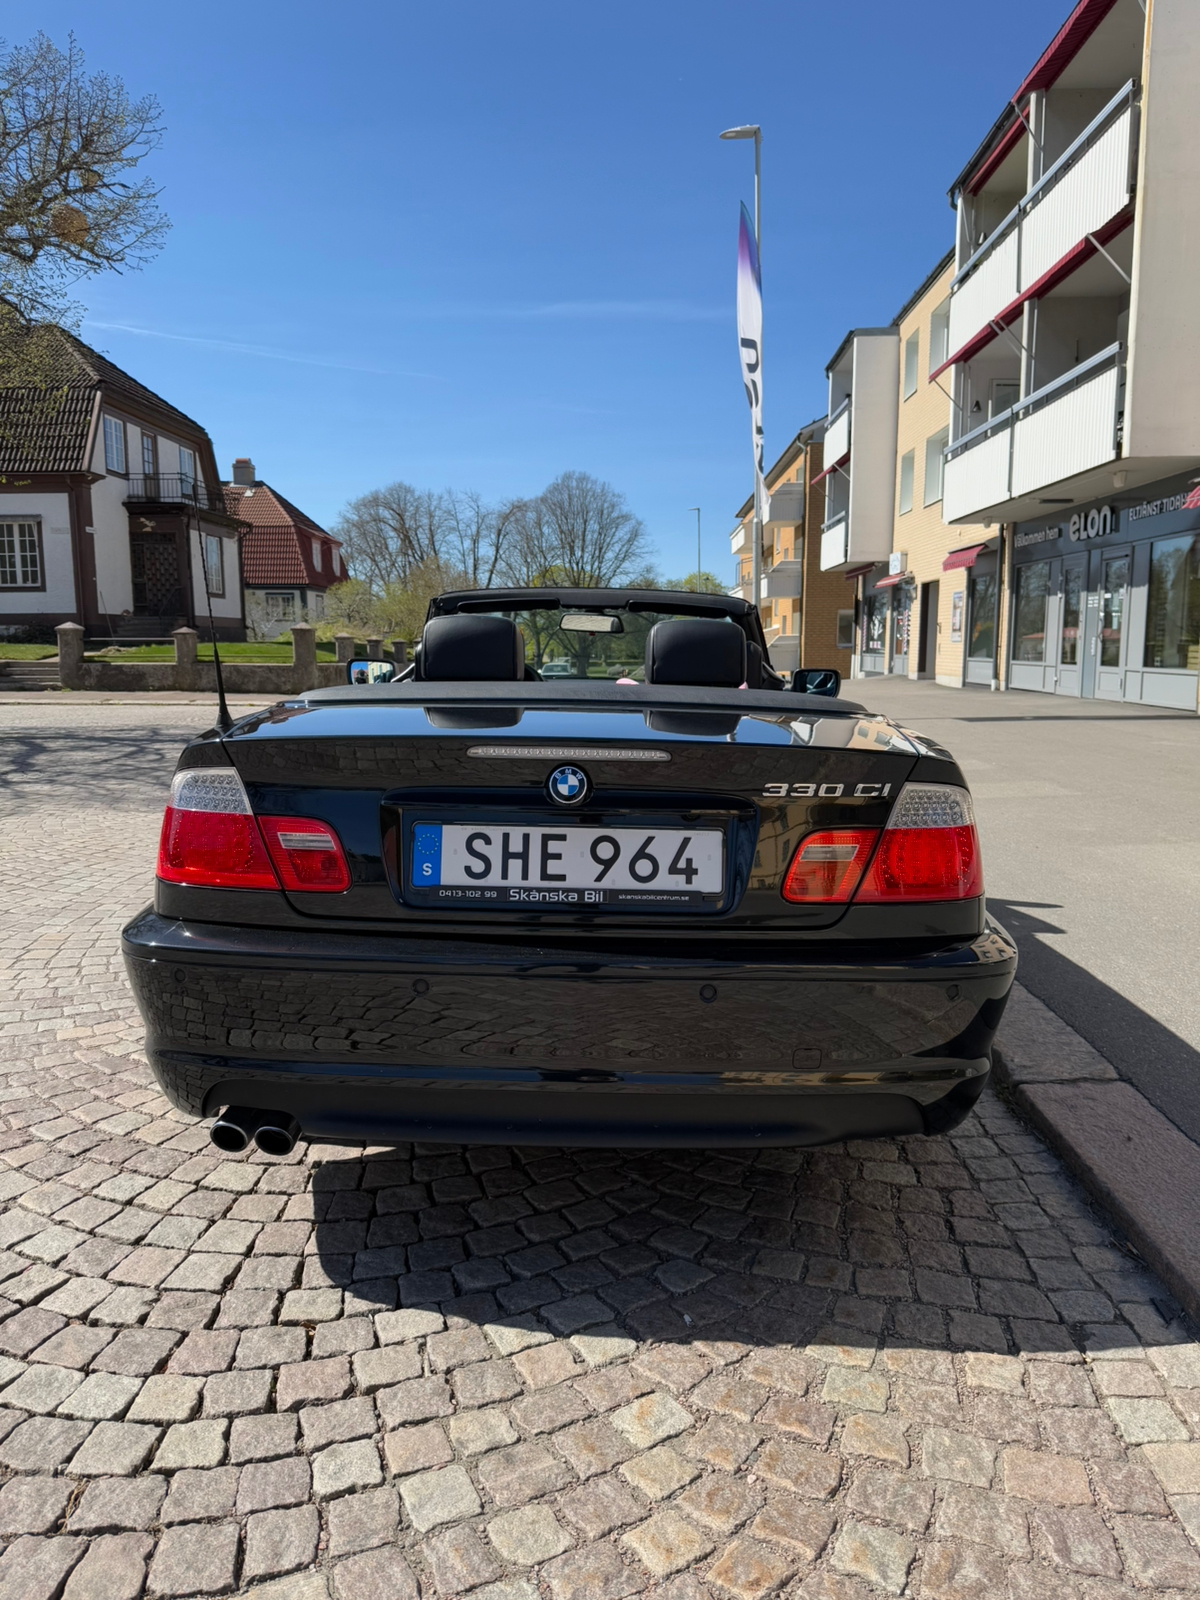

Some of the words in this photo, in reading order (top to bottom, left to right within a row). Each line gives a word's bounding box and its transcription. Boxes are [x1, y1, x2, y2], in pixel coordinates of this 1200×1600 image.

[554, 768, 583, 780] BMW
[762, 783, 844, 797] 330
[464, 831, 567, 882] SHE
[590, 835, 698, 885] 964
[422, 863, 433, 876] S
[439, 889, 481, 898] 0413-102
[484, 890, 497, 898] 99
[509, 889, 578, 902] Skånska
[584, 890, 604, 902] Bil
[618, 893, 690, 901] skanskabilcentrum.se
